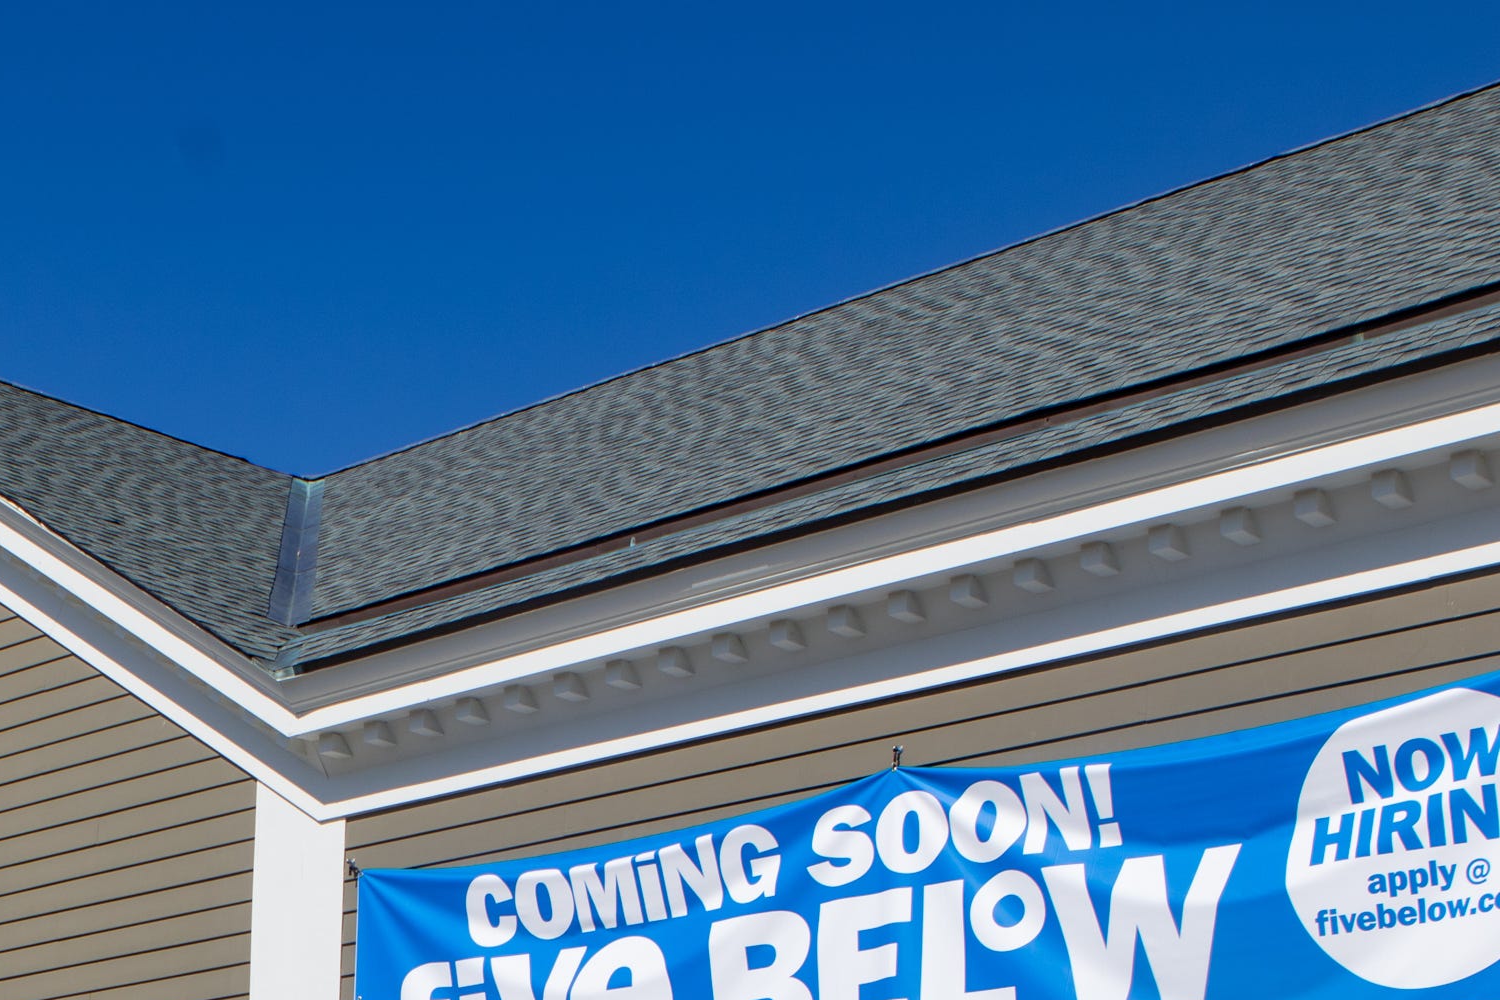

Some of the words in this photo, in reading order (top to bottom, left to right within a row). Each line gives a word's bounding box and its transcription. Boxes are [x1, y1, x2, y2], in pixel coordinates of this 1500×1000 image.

[1341, 723, 1500, 805] NOW
[806, 763, 1123, 887] SOON!
[1367, 860, 1457, 898] apply
[1466, 858, 1491, 885] @
[1315, 891, 1500, 937] fivebelow.c
